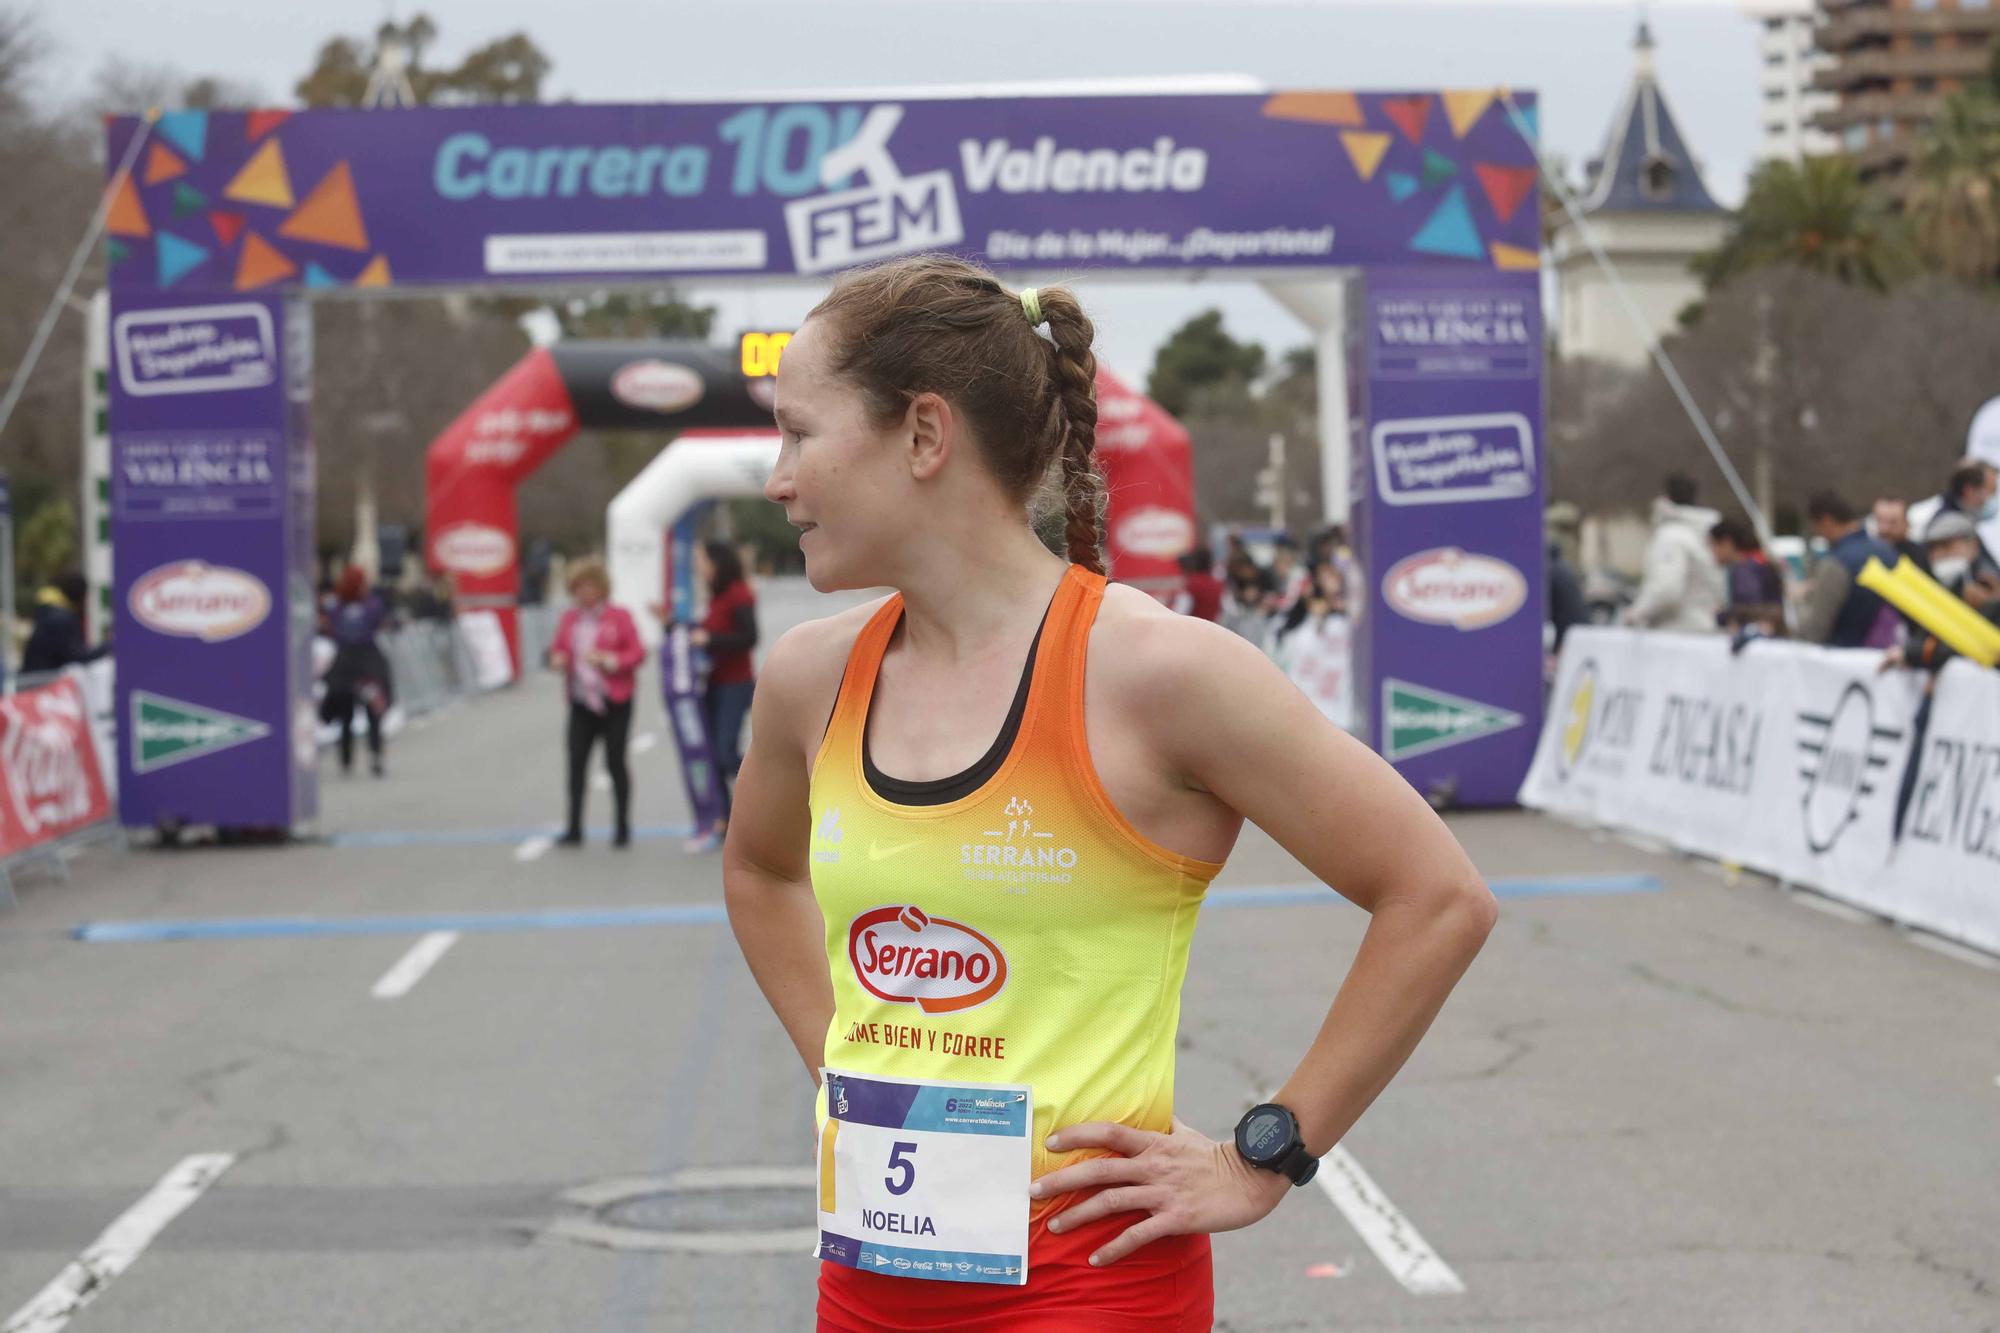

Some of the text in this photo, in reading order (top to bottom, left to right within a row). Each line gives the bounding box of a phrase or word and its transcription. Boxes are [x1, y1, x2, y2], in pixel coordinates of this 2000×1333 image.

[434, 104, 1207, 199] Carrera 10K Valencia
[802, 175, 952, 266] FEM
[1911, 736, 2000, 864] ENG
[960, 844, 1077, 869] SERRANO
[862, 930, 991, 984] Serrano
[884, 1023, 922, 1050] BIEN
[928, 1029, 937, 1052] Y
[943, 1031, 1006, 1060] CORRE
[1256, 1124, 1280, 1149] 34:00
[884, 1140, 918, 1196] 5
[862, 1208, 937, 1237] NOELIA
